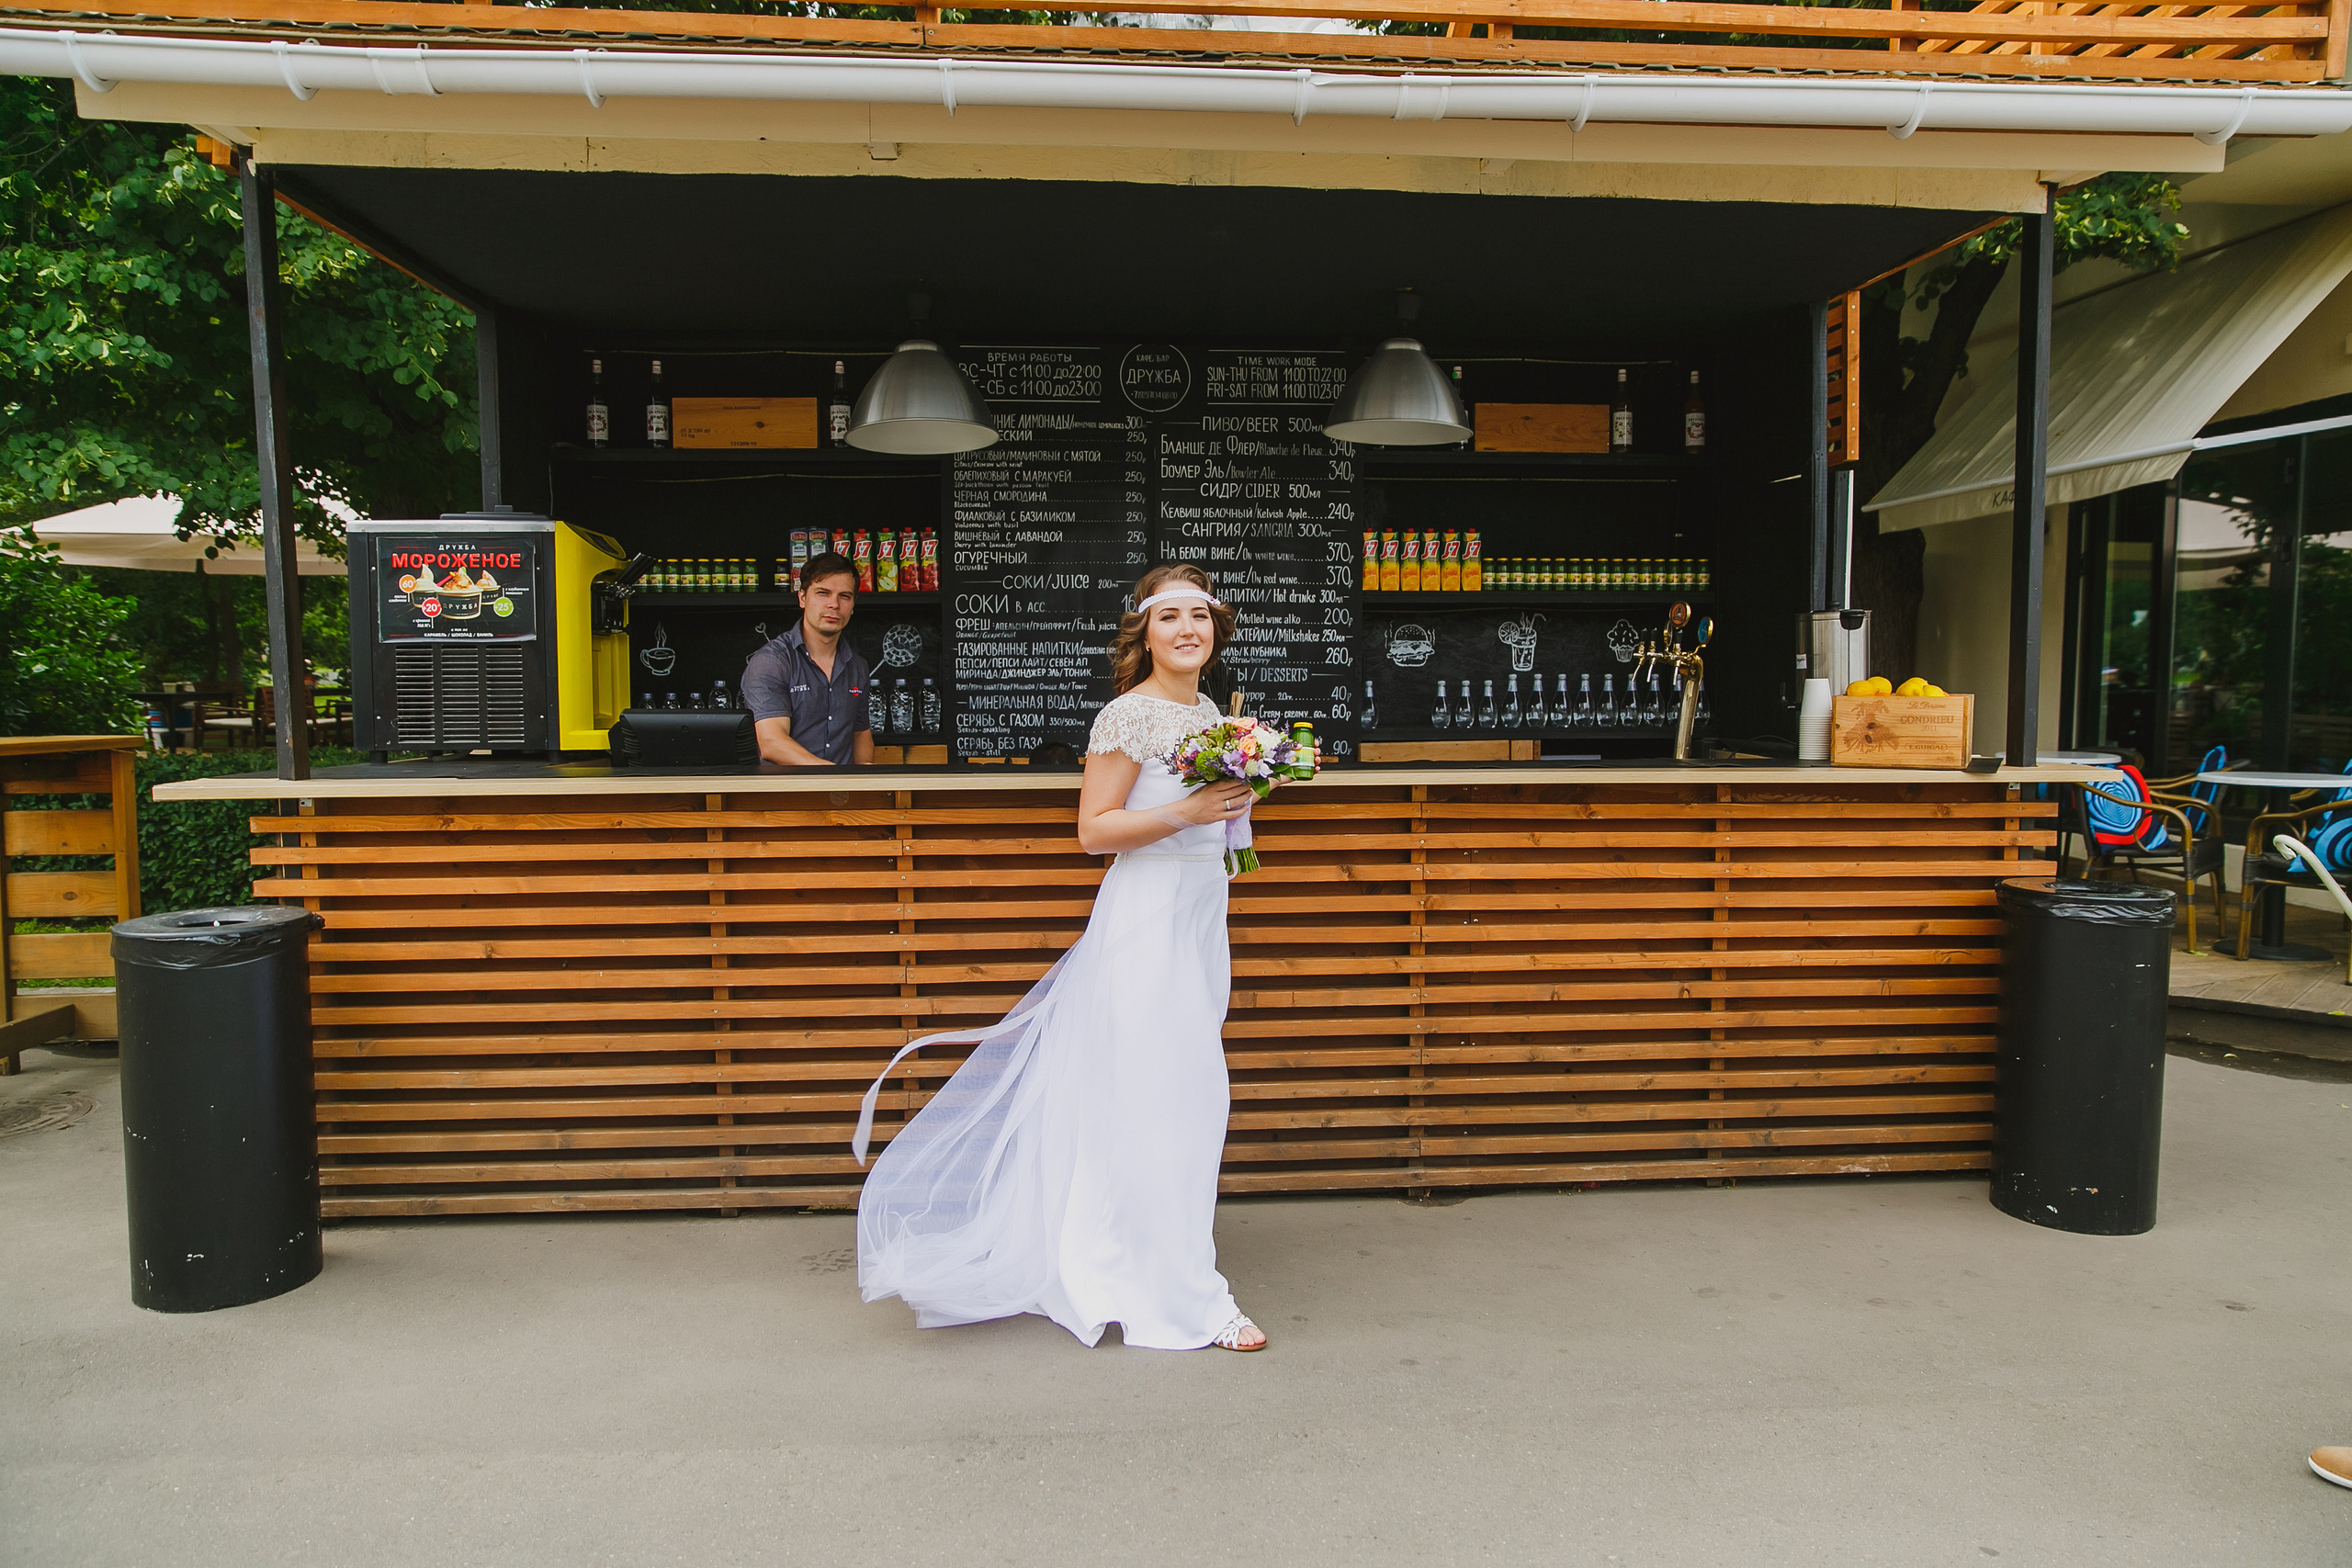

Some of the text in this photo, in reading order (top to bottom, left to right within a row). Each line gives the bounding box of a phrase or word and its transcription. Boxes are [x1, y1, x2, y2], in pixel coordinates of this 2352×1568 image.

[988, 352, 1072, 363] ВРЕМЯ РАБОТЫ
[1238, 355, 1317, 367] TIME WORK MODE
[1125, 368, 1182, 385] ДРУЖБА
[1206, 367, 1248, 381] SUN-THU
[1250, 367, 1278, 382] FROM
[1206, 383, 1248, 398] FRI-SAT
[1250, 383, 1279, 398] FROM
[1071, 449, 1101, 461] МЯТОЙ
[954, 469, 1010, 481] ОБЛЕПИХОВЫЙ
[1023, 469, 1072, 482] МАРАКУЕЙ
[1260, 466, 1276, 479] Ale
[954, 491, 989, 502] ЧЕРНАЯ
[993, 491, 1047, 502] СМОРОДИНА
[1245, 483, 1281, 499] CIDER
[1288, 483, 1321, 499] 500мл
[954, 510, 1006, 522] ФИАЛКОВЫЙ
[1020, 511, 1076, 522] БАЗИЛИКОМ
[1286, 507, 1307, 520] Apple
[1014, 530, 1063, 543] ЛАВАНДОЙ
[391, 553, 521, 569] МОРОЖЕНОЕ
[954, 551, 1027, 564] ОГУРЕЧНЫЙ
[1273, 589, 1287, 603] Hot
[955, 593, 1009, 614] СОКИ
[955, 617, 990, 631] ФРЕШ
[1283, 613, 1301, 625] alko
[957, 642, 1028, 657] ГАЗИРОВАННЫЕ
[1075, 658, 1088, 667] АП
[1260, 667, 1308, 682] DESSERTS
[968, 694, 1044, 710] МИНЕРАЛЬНАЯ
[956, 713, 996, 727] СЕРЯБЬ
[1010, 714, 1045, 727] ГАЗОМ
[1900, 715, 1954, 725] CONDRIEU
[956, 737, 994, 750] СЕРЯБЬ
[998, 737, 1015, 750] БЕЗ
